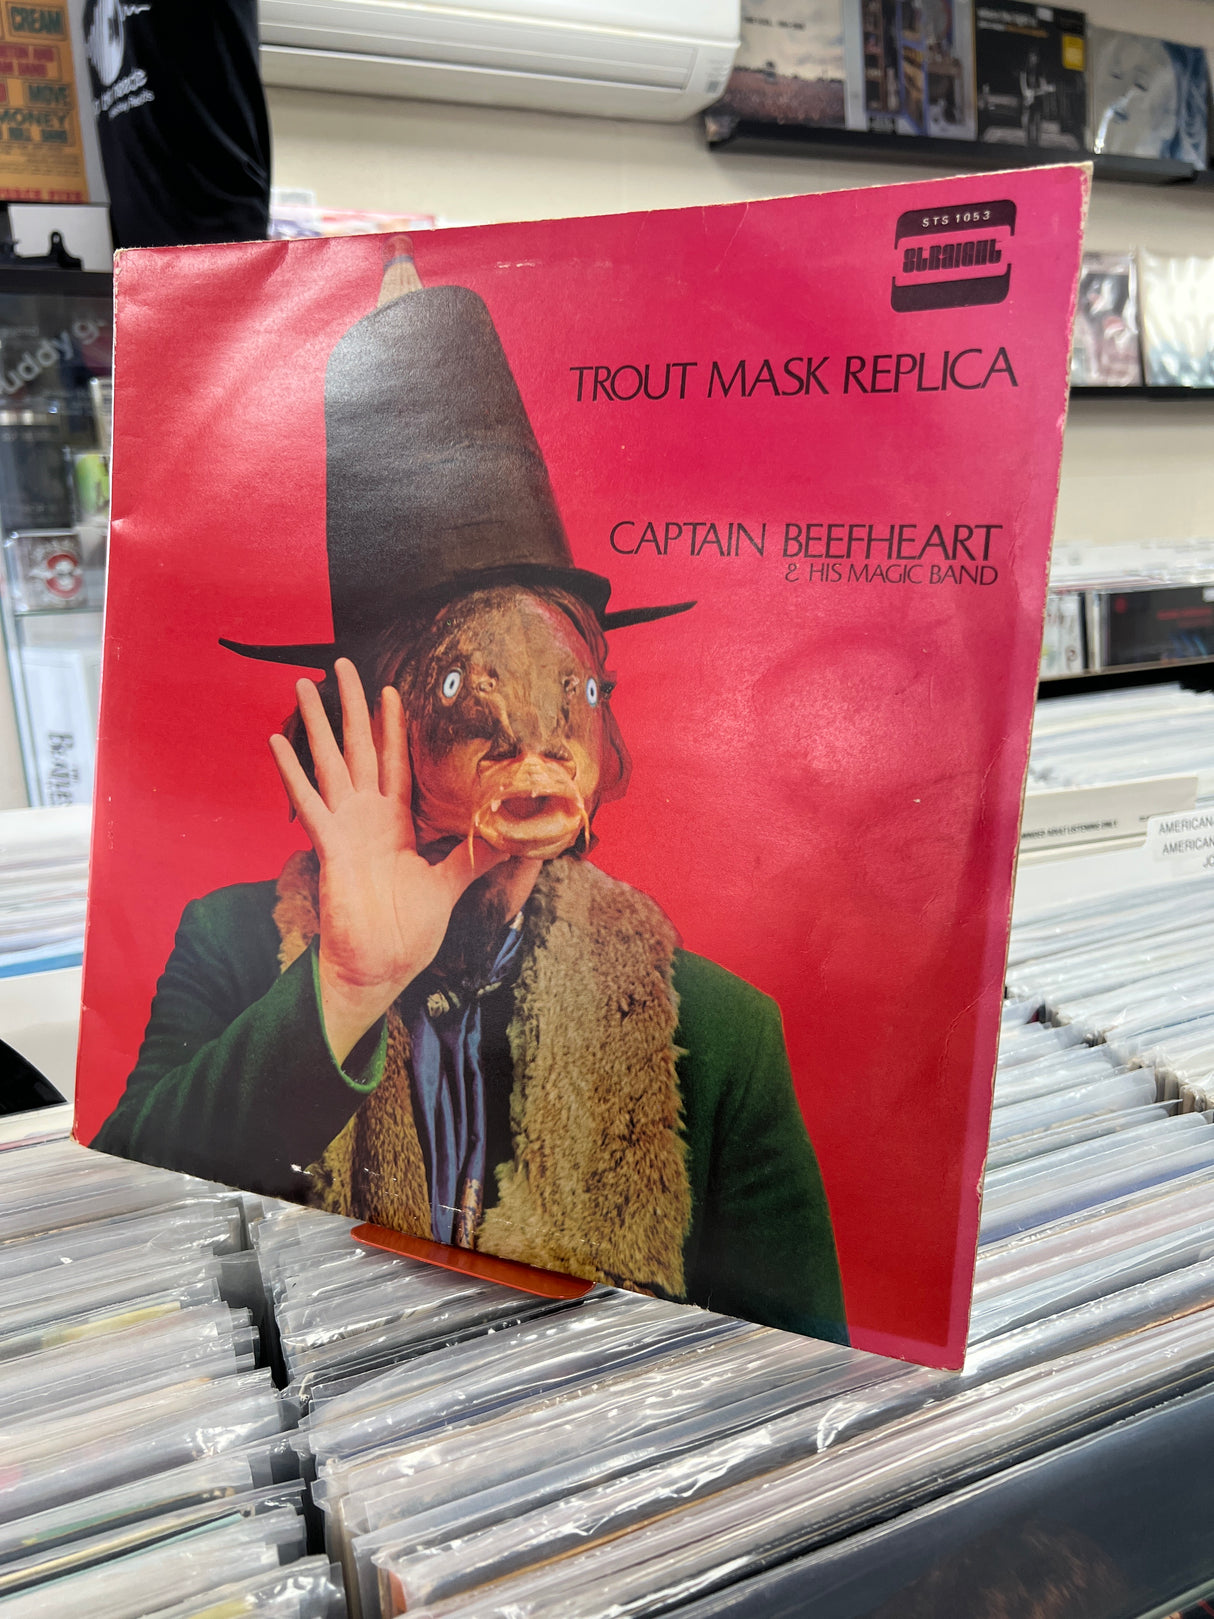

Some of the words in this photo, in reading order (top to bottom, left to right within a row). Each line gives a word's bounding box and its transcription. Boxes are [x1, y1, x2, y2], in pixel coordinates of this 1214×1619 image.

[922, 215, 949, 228] STS
[955, 210, 991, 224] 1053
[0, 330, 74, 394] uddy
[569, 362, 698, 402] TROUT
[707, 356, 830, 398] MASK
[843, 347, 1019, 394] REPLICA
[609, 521, 767, 557] CAPTAIN
[782, 523, 1004, 561] BEEFHEART
[785, 563, 799, 582] &
[809, 563, 842, 582] HIS
[848, 563, 923, 584] MAGIC
[929, 565, 999, 586] BAND
[1158, 816, 1214, 834] AMERICAN
